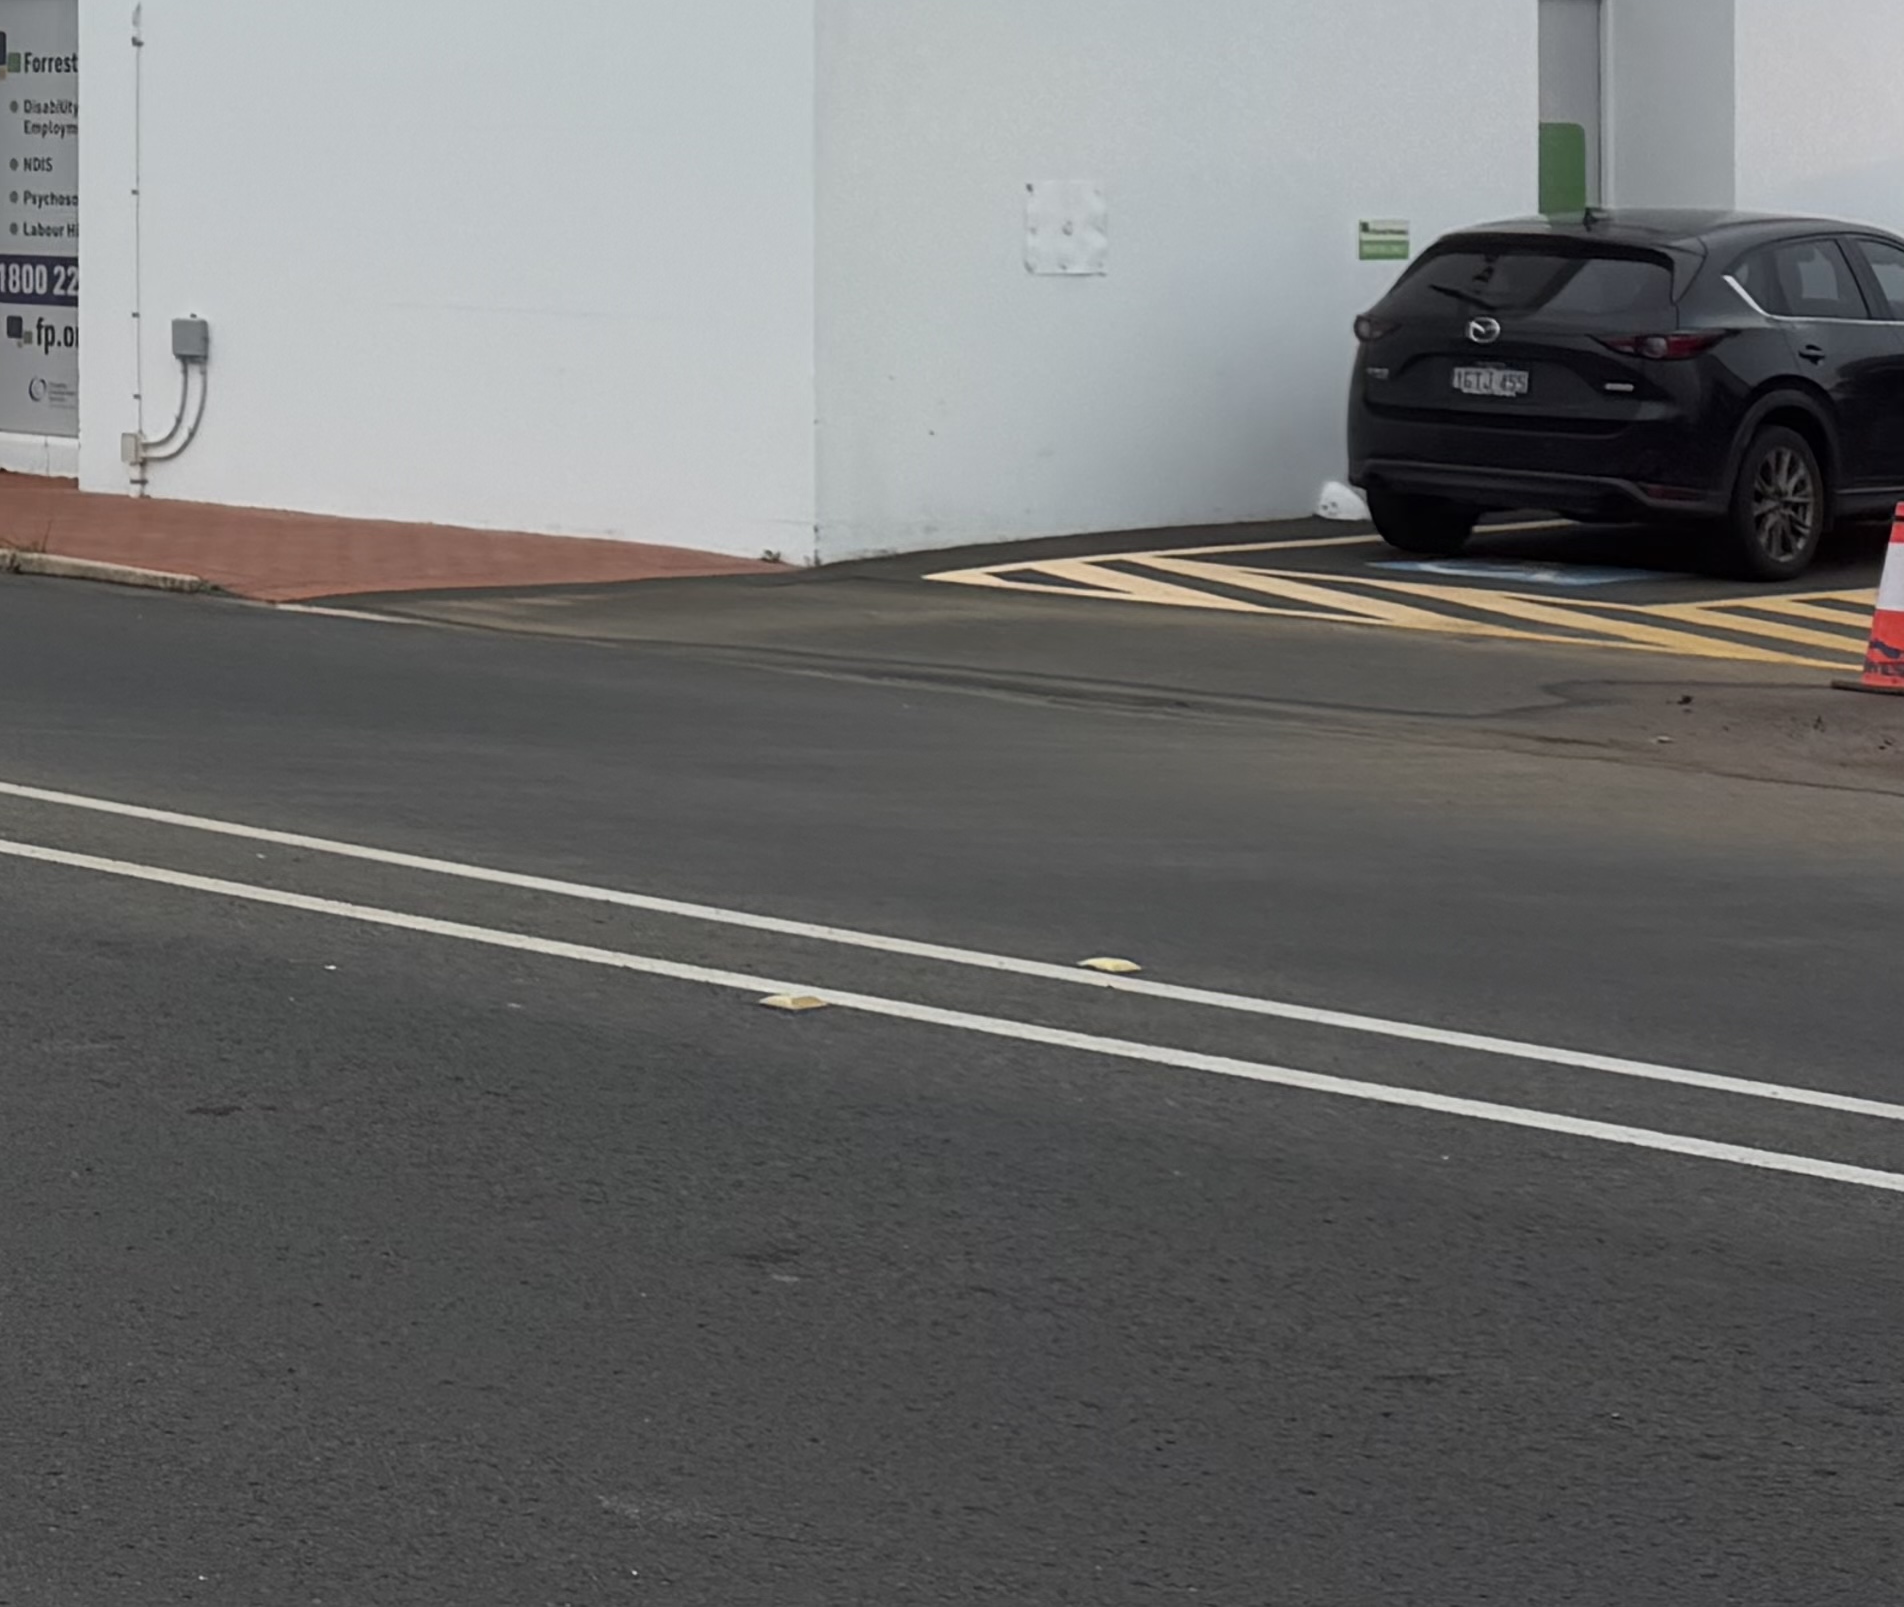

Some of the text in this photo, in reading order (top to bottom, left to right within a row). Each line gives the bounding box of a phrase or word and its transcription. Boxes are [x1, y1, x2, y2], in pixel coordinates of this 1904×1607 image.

[24, 51, 78, 73] Forrest
[23, 157, 53, 172] NDIS
[23, 222, 65, 237] Labour
[52, 265, 79, 296] 22
